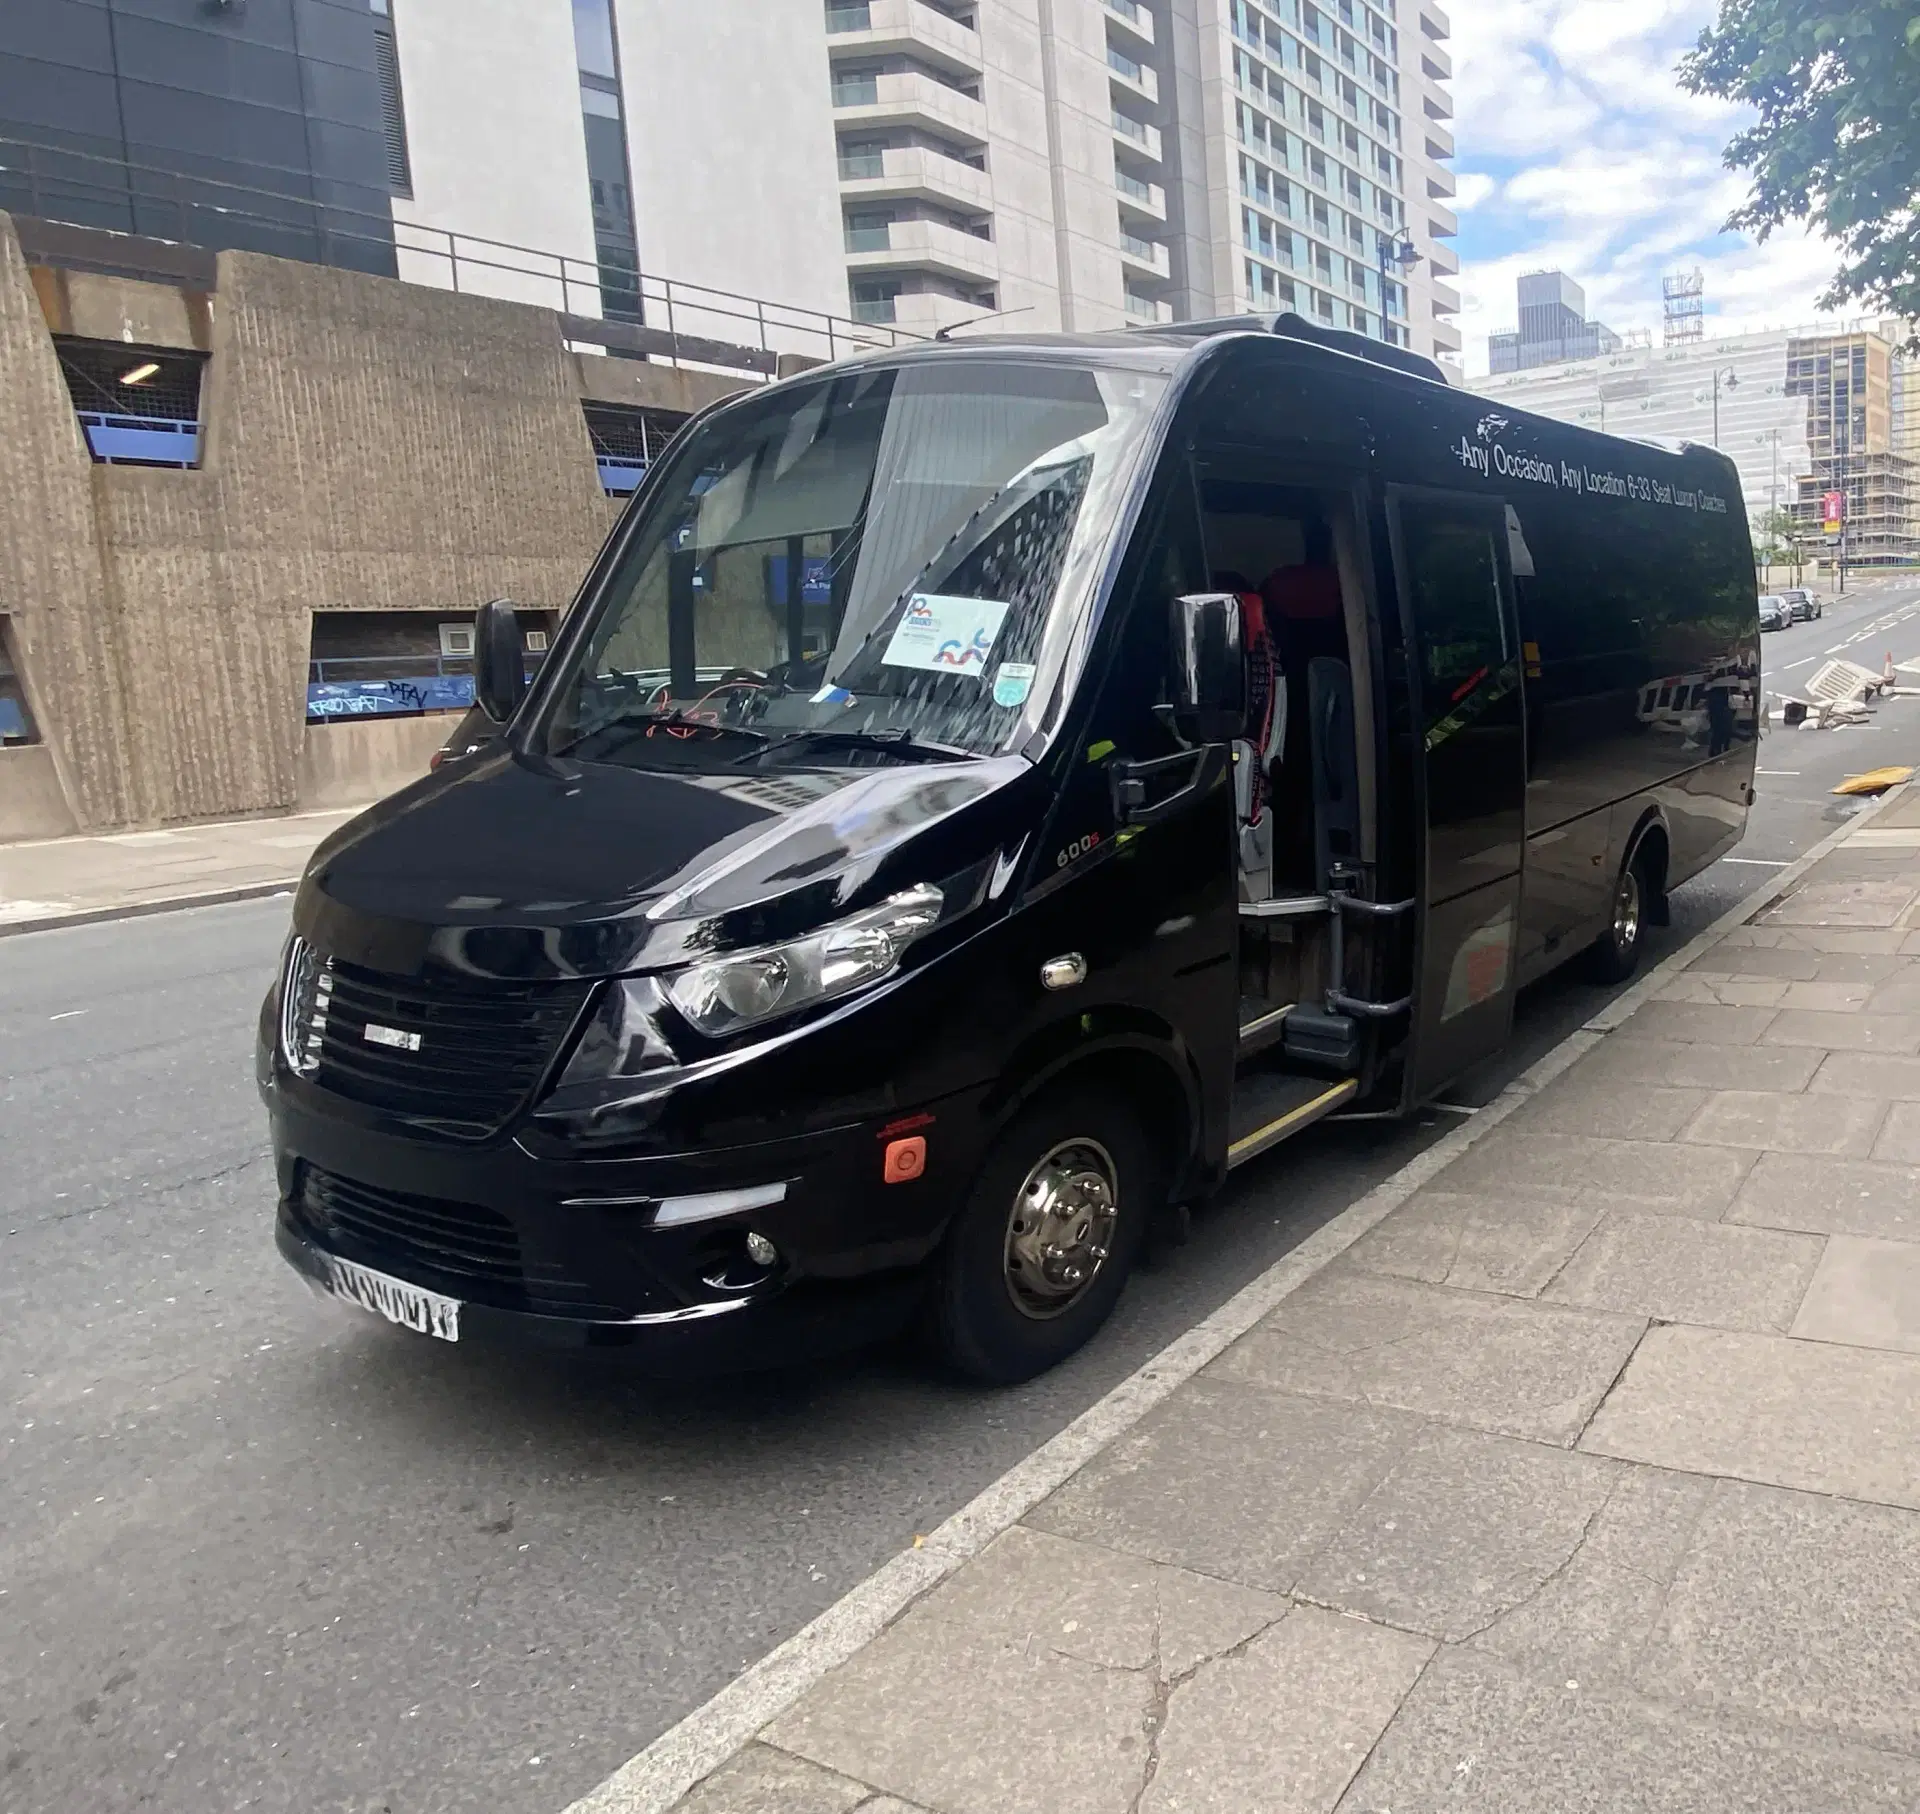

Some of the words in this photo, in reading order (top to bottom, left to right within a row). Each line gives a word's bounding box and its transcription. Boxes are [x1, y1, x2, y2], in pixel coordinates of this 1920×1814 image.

[1461, 436, 1489, 477] Any
[1493, 444, 1559, 489] Occasion,
[1561, 460, 1582, 494] Any
[1583, 465, 1627, 497] Location
[1627, 474, 1651, 501] 6-33
[1651, 479, 1674, 504] Seat
[1671, 483, 1698, 512] Luxury
